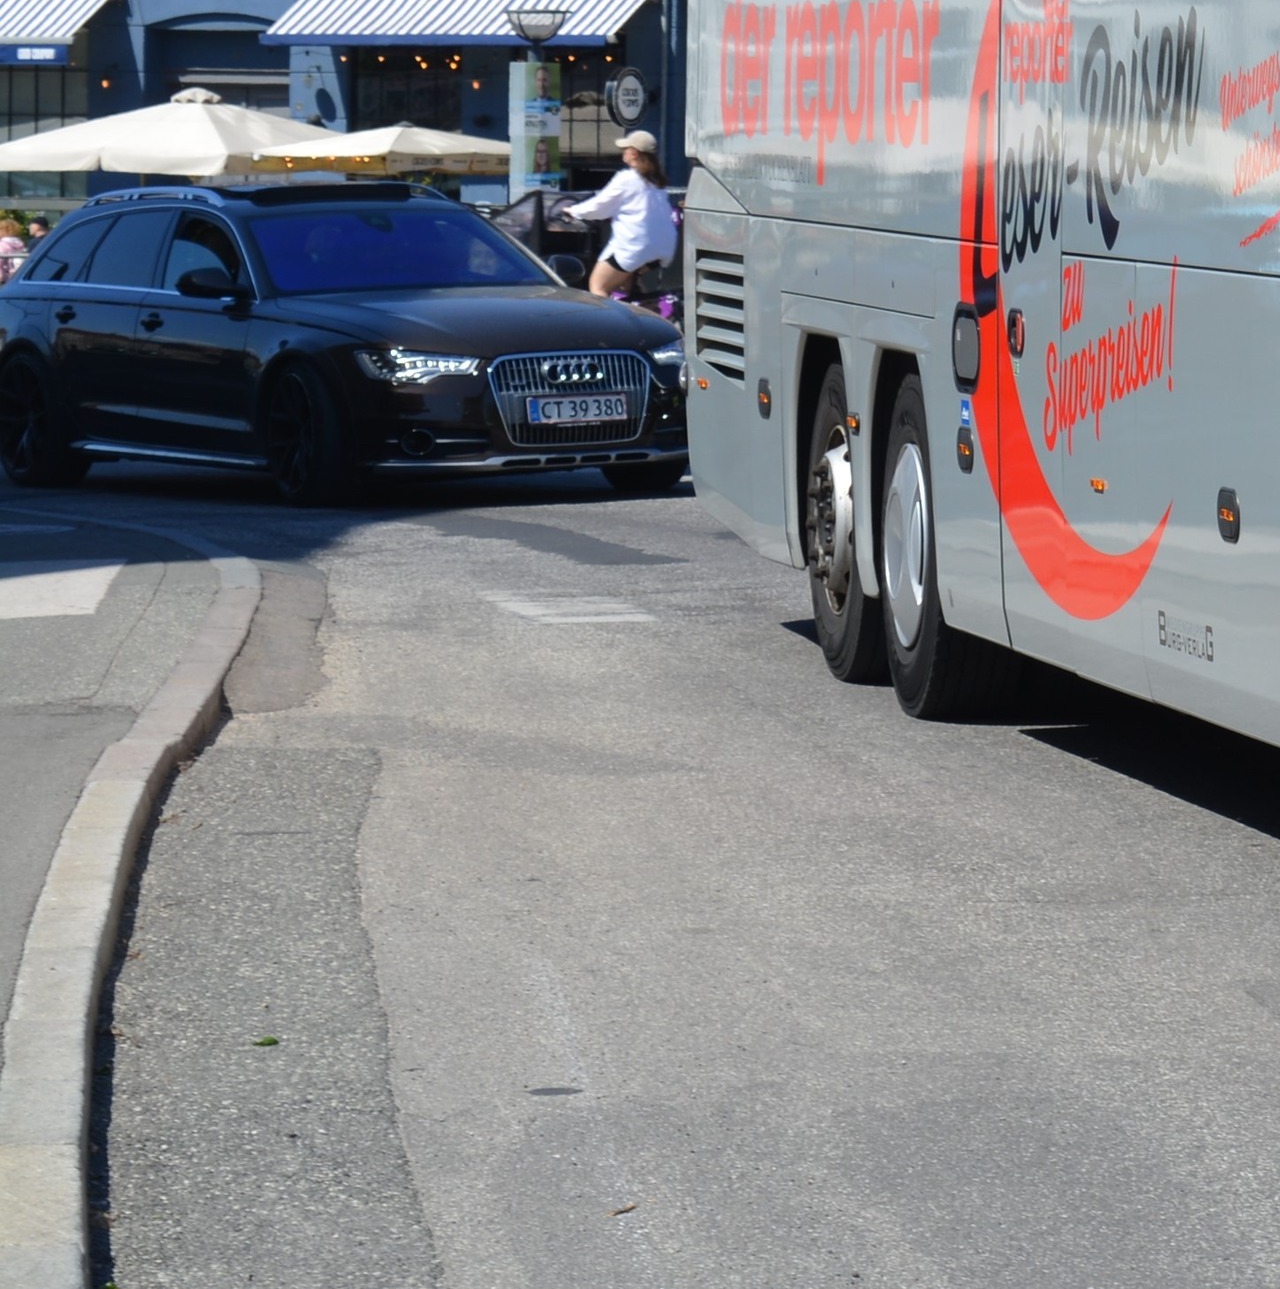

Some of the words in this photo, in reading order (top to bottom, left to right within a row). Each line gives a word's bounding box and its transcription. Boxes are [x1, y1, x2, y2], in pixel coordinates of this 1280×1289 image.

[1003, 19, 1073, 105] reporter
[1062, 260, 1085, 332] zu
[541, 401, 564, 419] CT
[568, 400, 590, 418] 39
[593, 397, 625, 416] 380
